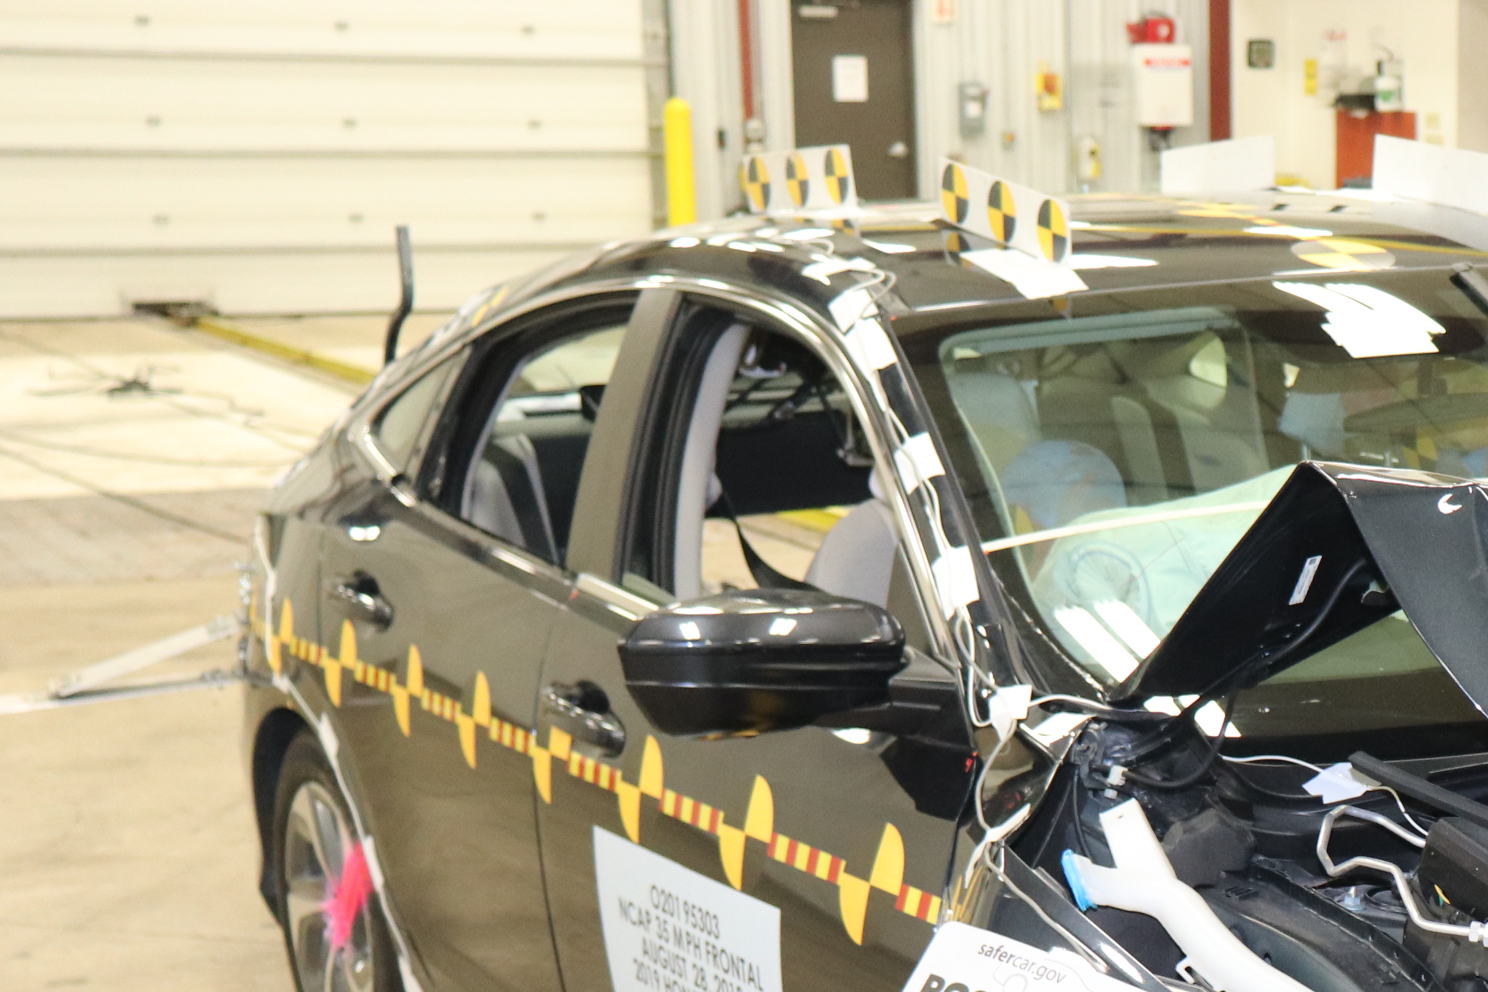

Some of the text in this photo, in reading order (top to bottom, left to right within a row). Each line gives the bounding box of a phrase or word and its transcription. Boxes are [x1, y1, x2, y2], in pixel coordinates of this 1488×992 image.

[618, 896, 764, 992] NCAP 35 MPH FRONTAL
[642, 936, 688, 981] AUGUST
[977, 943, 1067, 984] safercar.gov
[633, 957, 660, 992] 2019
